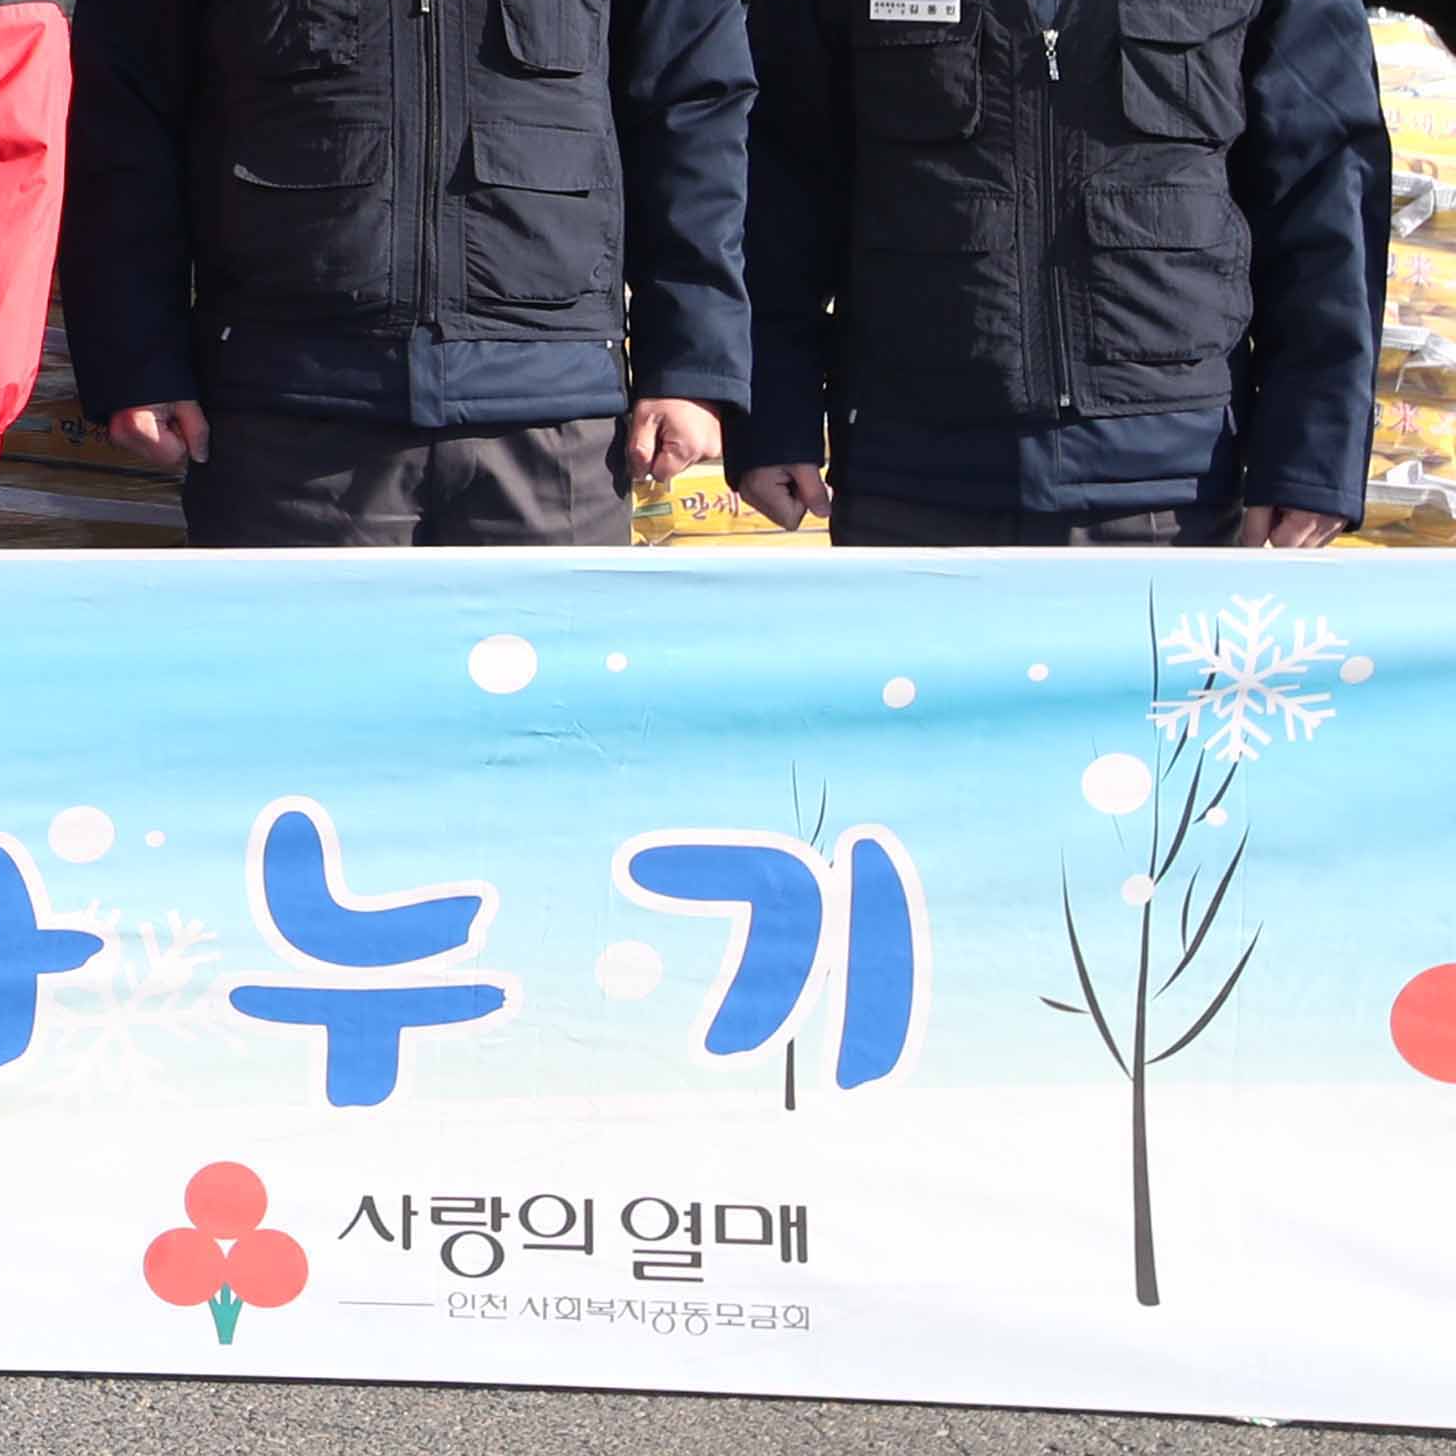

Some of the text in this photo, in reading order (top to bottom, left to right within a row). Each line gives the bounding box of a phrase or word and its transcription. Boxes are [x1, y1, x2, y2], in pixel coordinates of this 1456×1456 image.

[338, 1194, 808, 1283] 사랑의 열매
[447, 1291, 810, 1337] 인천 사회복지공동모금회
